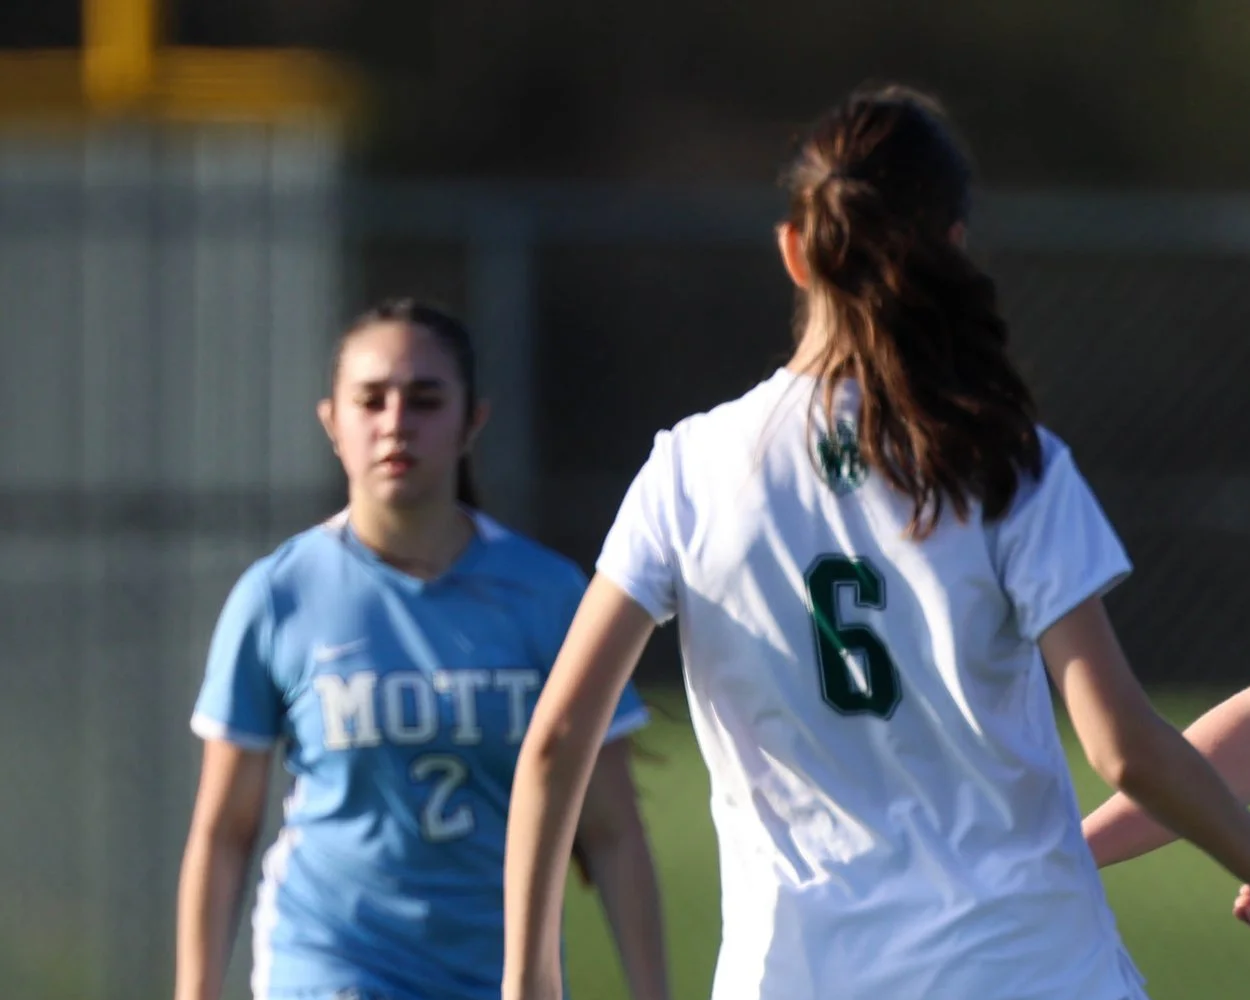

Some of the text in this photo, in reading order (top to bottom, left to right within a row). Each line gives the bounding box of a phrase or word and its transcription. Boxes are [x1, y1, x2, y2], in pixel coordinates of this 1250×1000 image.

[804, 553, 903, 721] 6
[314, 669, 541, 749] MOTT
[412, 752, 475, 842] 2
